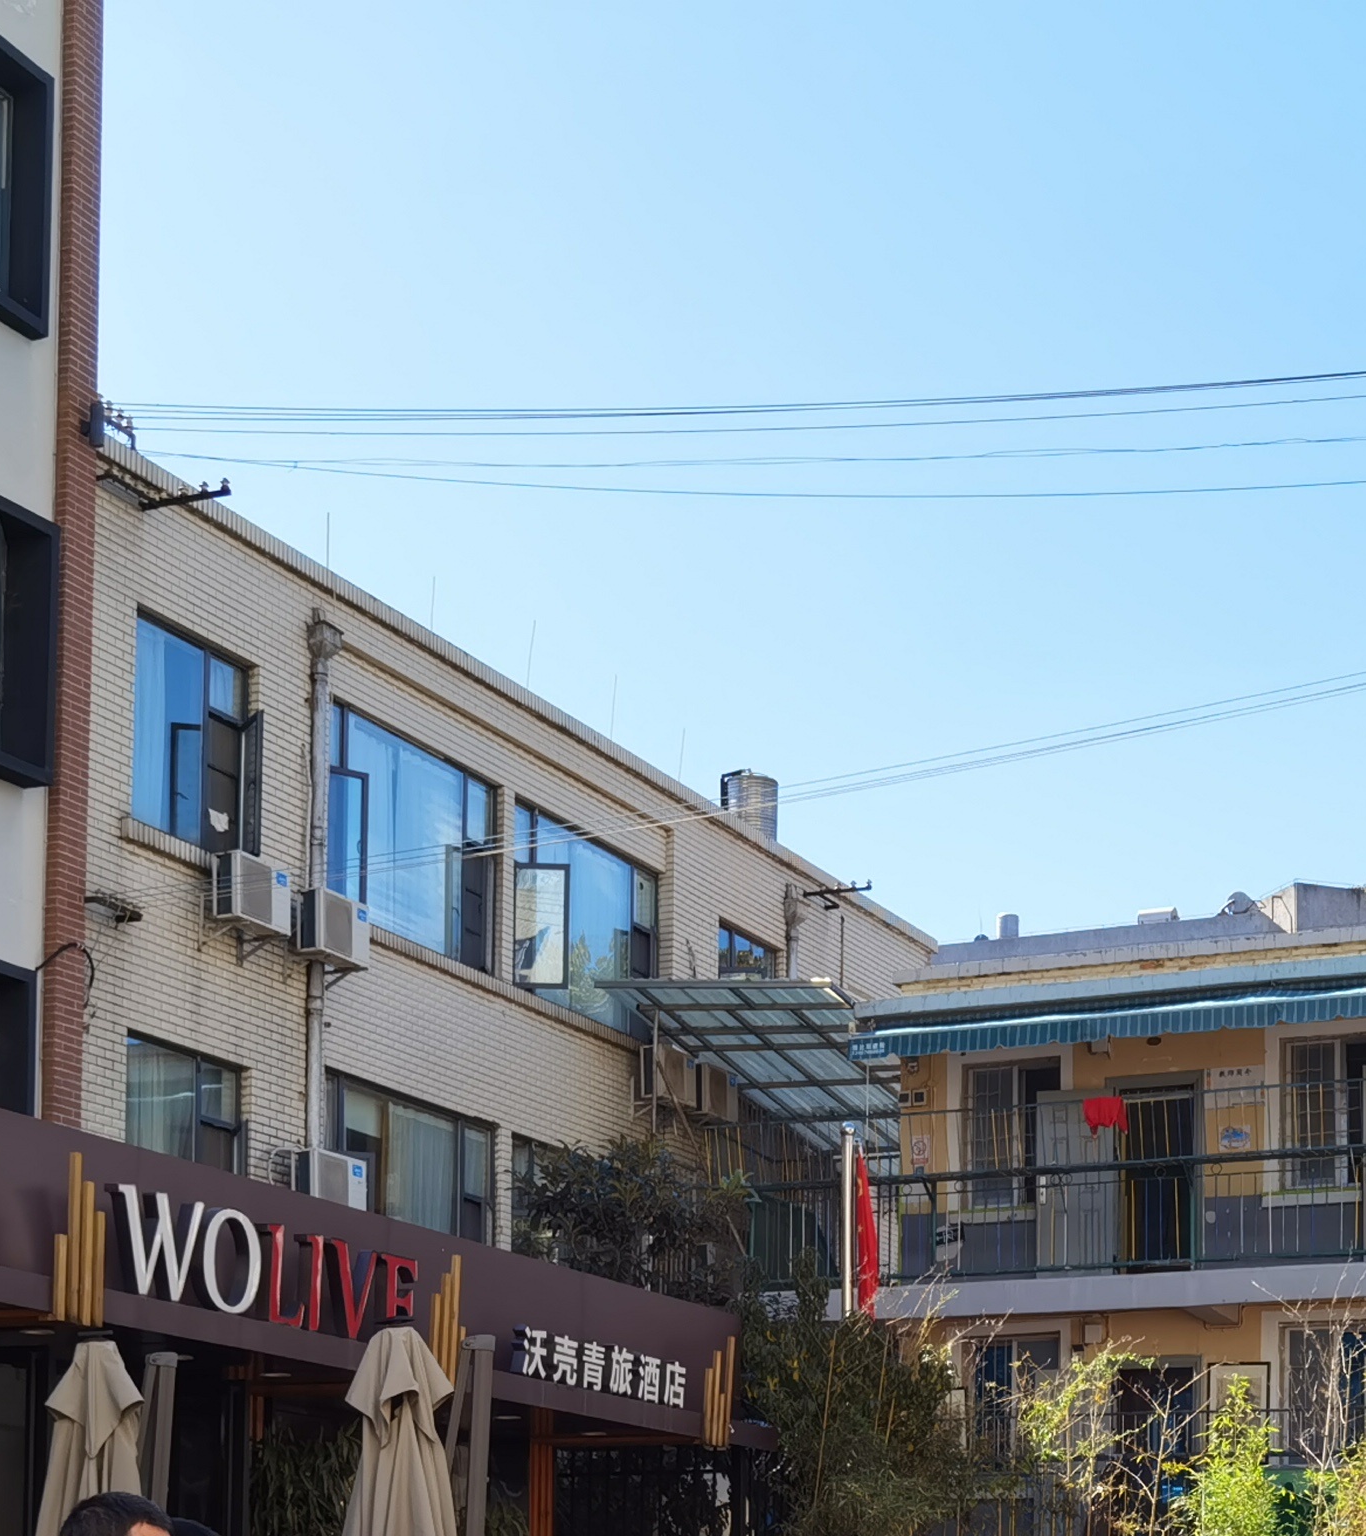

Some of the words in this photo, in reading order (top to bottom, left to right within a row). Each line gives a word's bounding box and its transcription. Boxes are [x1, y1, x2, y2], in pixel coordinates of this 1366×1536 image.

[106, 1183, 418, 1340] WOLIVE
[517, 1325, 688, 1408] 沃壳青旅酒店
